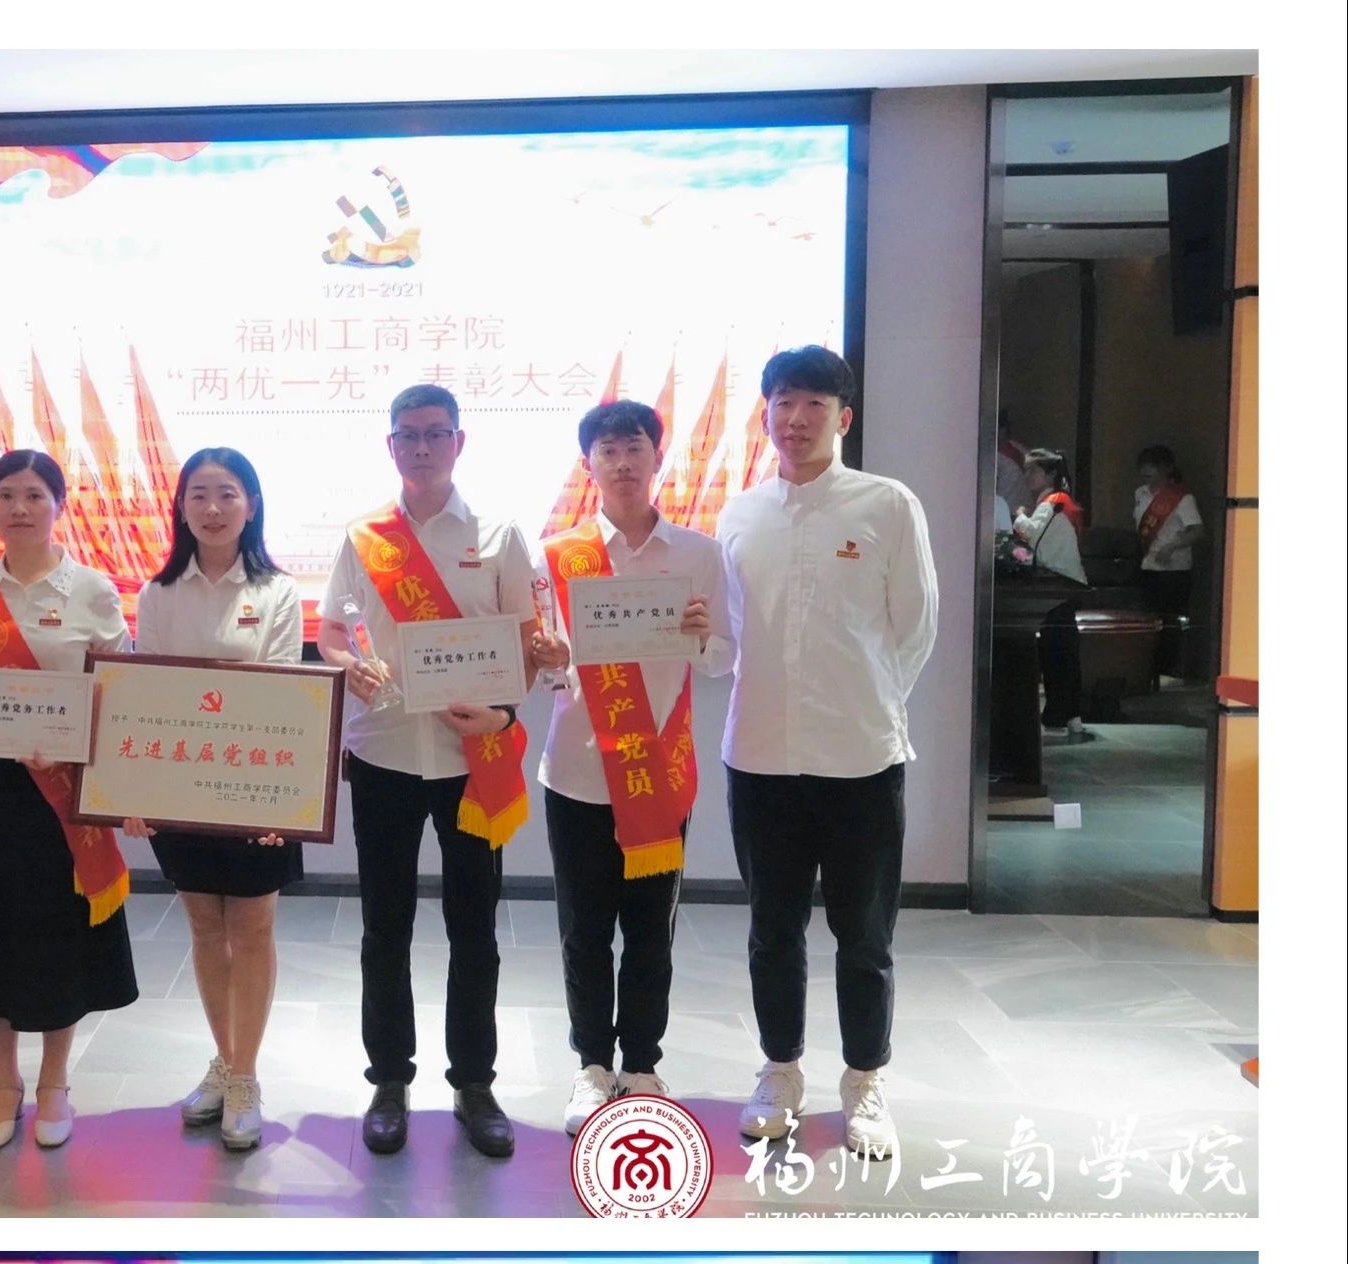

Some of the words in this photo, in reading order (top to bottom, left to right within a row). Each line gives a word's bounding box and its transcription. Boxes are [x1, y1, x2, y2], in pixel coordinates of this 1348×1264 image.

[322, 281, 424, 299] 1921-2021
[235, 314, 506, 353] 福州工商学院
[420, 362, 599, 401] 表彰大会
[593, 607, 675, 620] 优秀共产党员
[423, 651, 498, 665] 优秀党务工作者
[595, 663, 654, 800] 共产党员
[117, 735, 296, 768] 先进基层党组织
[193, 779, 302, 797] 中共福州工商学院委员会
